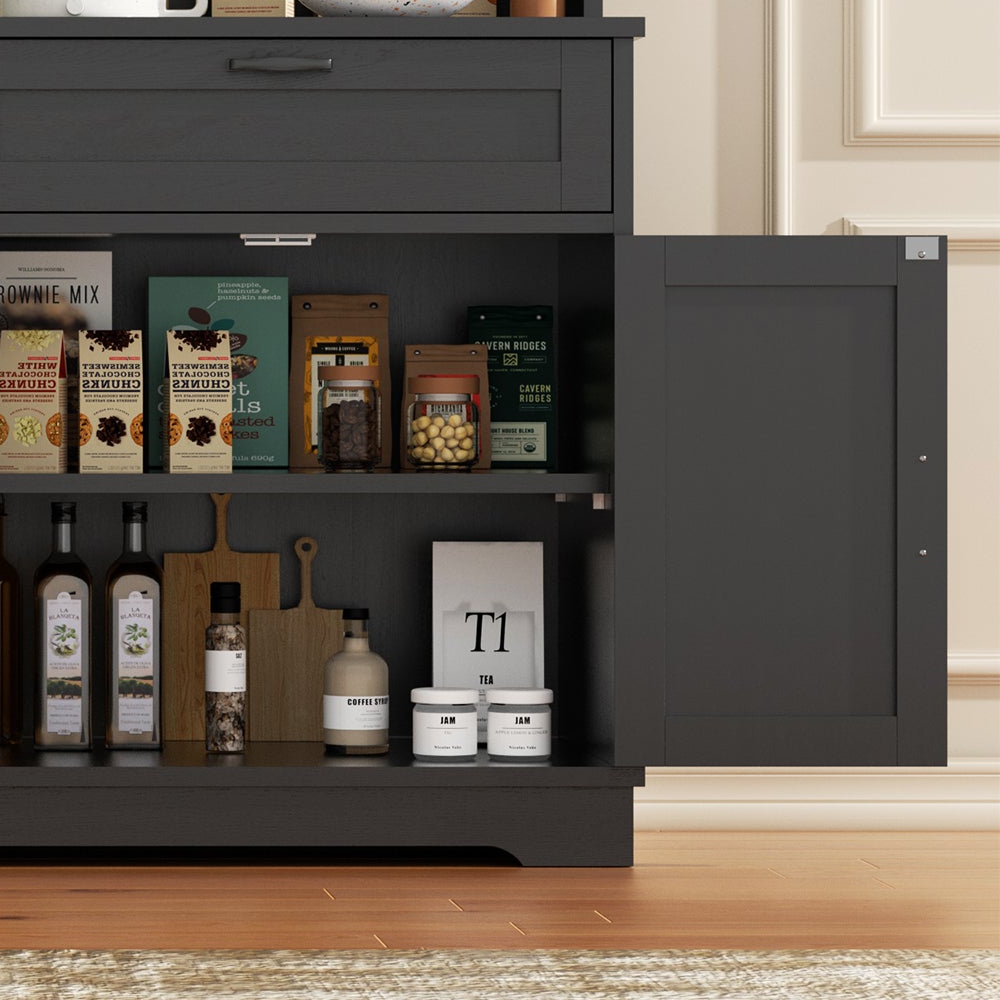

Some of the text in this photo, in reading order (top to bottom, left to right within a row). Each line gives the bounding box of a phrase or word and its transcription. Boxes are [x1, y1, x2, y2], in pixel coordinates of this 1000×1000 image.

[70, 285, 100, 304] MIX
[513, 340, 547, 351] RIDGES
[520, 384, 551, 393] CAVERN
[520, 394, 552, 403] RIDGES
[465, 611, 510, 653] T1
[479, 675, 494, 685] TEA
[440, 716, 456, 724] JAM
[515, 716, 531, 724] JAM
